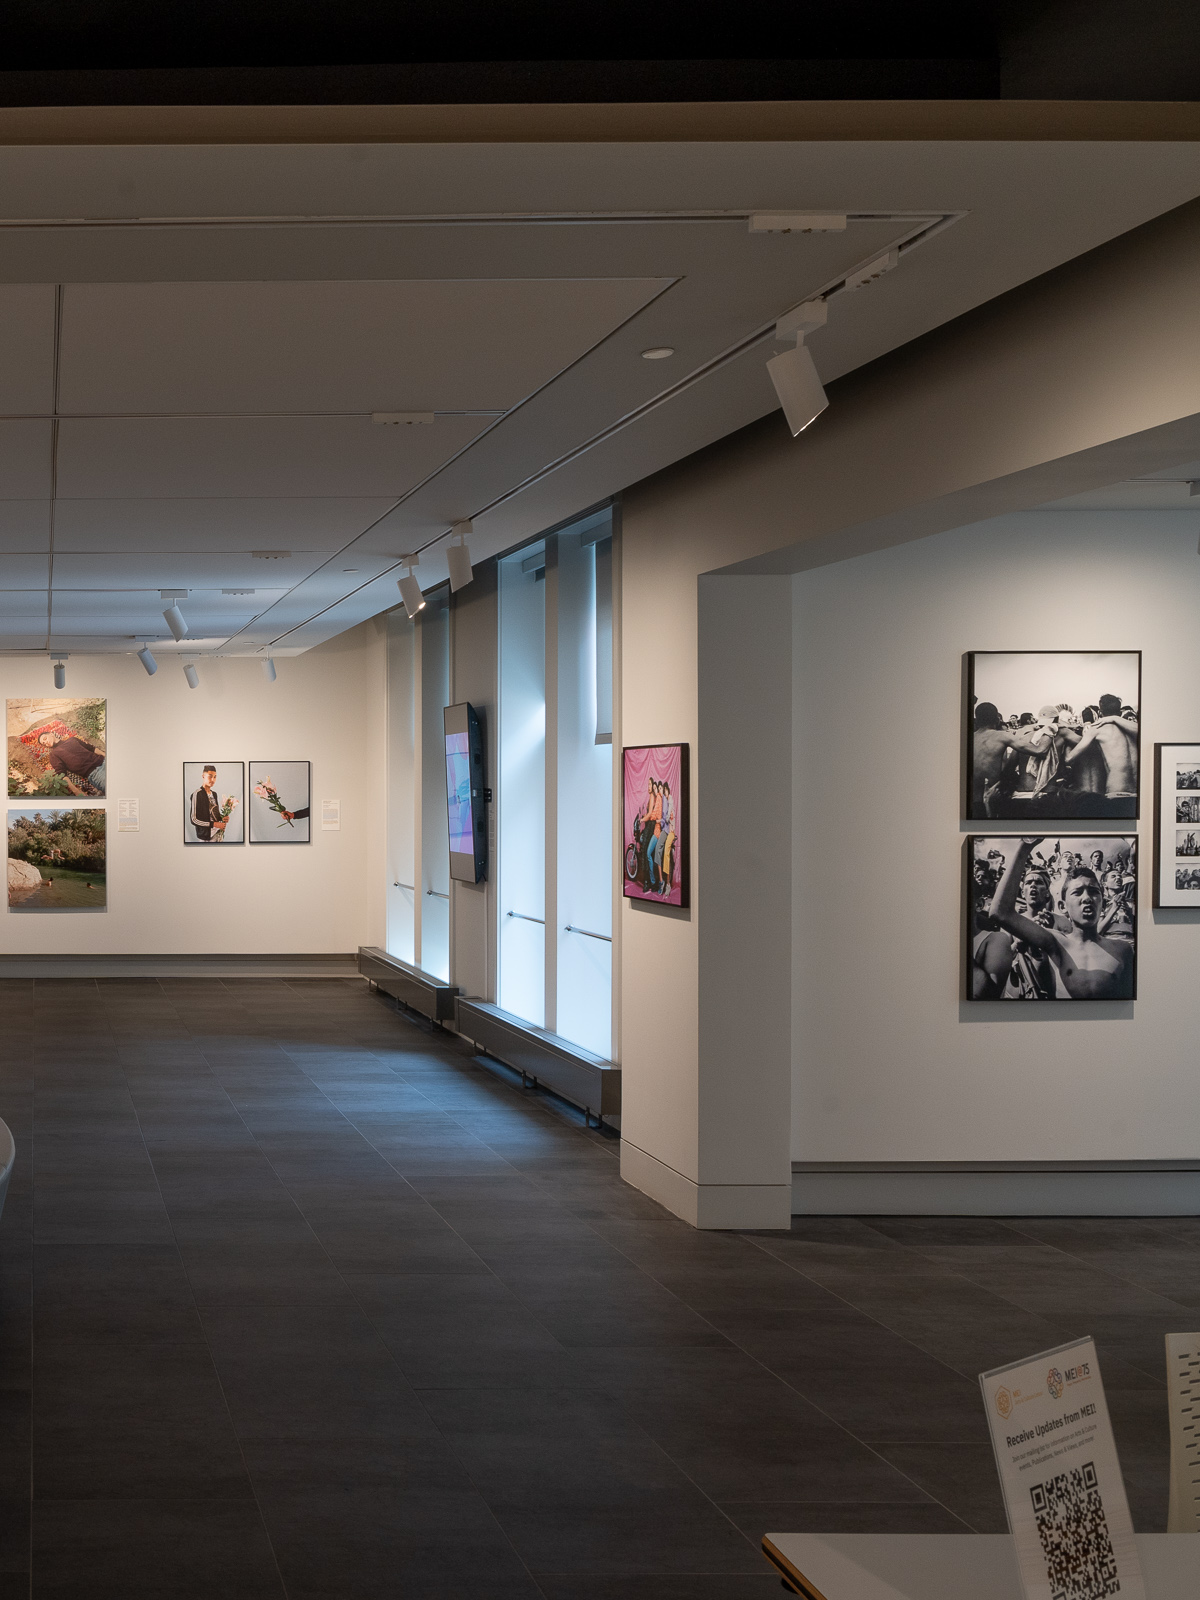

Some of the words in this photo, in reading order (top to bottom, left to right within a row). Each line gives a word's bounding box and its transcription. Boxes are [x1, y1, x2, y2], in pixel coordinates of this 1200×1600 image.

[1064, 1363, 1090, 1381] MEI@75
[1006, 1429, 1034, 1448] Receive
[1034, 1418, 1064, 1437] Updates
[1064, 1411, 1081, 1425] from
[1080, 1403, 1097, 1418] MEI!
